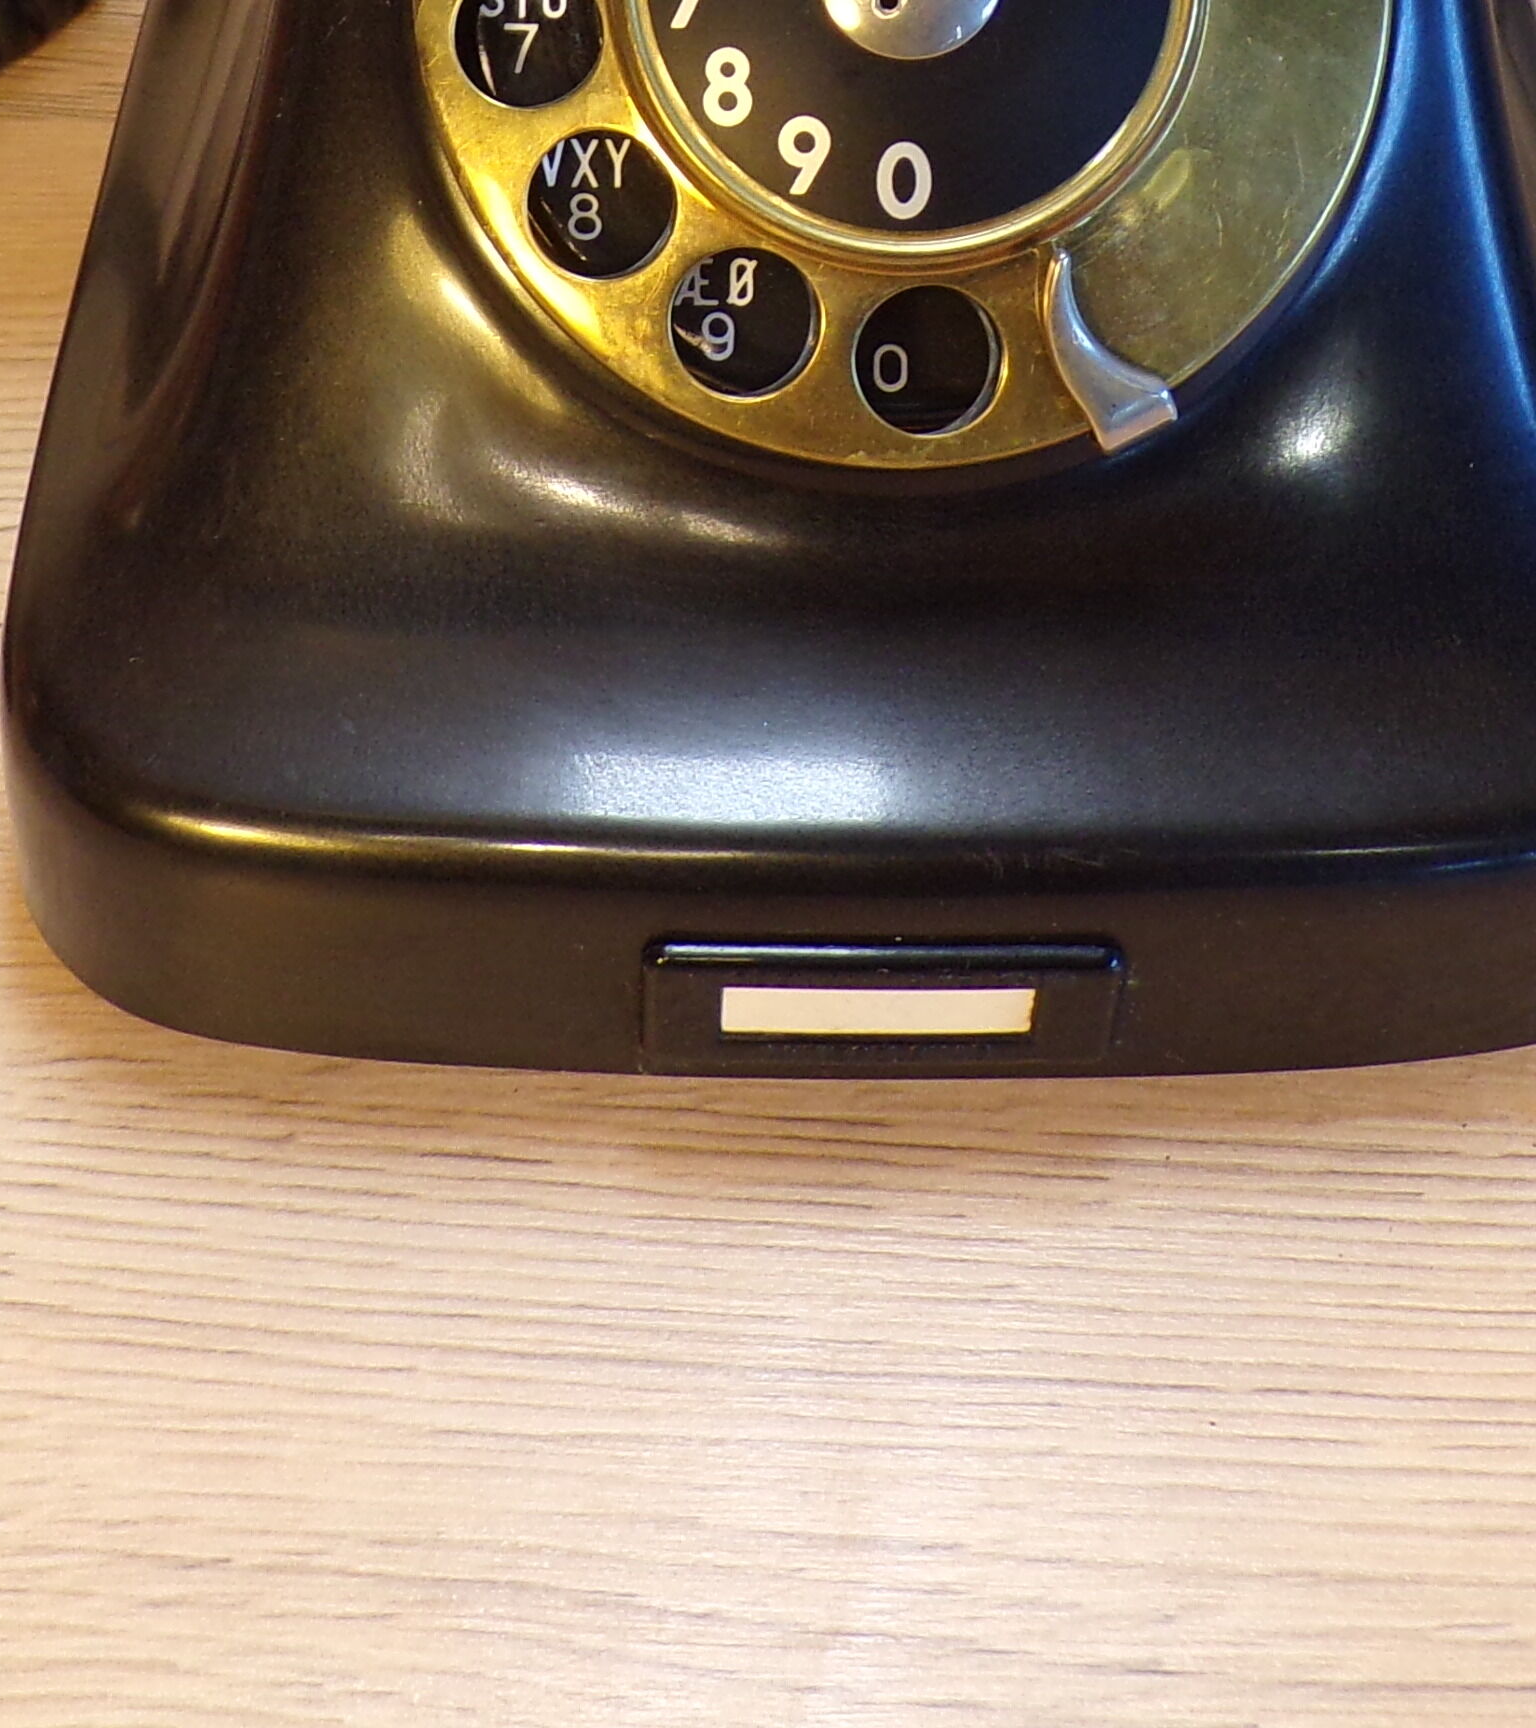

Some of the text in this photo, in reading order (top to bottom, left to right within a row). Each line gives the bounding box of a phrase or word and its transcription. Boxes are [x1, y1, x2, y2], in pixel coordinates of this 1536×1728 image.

[503, 23, 540, 74] 7
[702, 47, 753, 126] 8
[542, 139, 631, 188] VXY
[777, 115, 832, 194] 9
[876, 141, 932, 220] 0
[567, 193, 603, 240] 8
[701, 312, 735, 361] 9
[872, 343, 909, 392] 0
